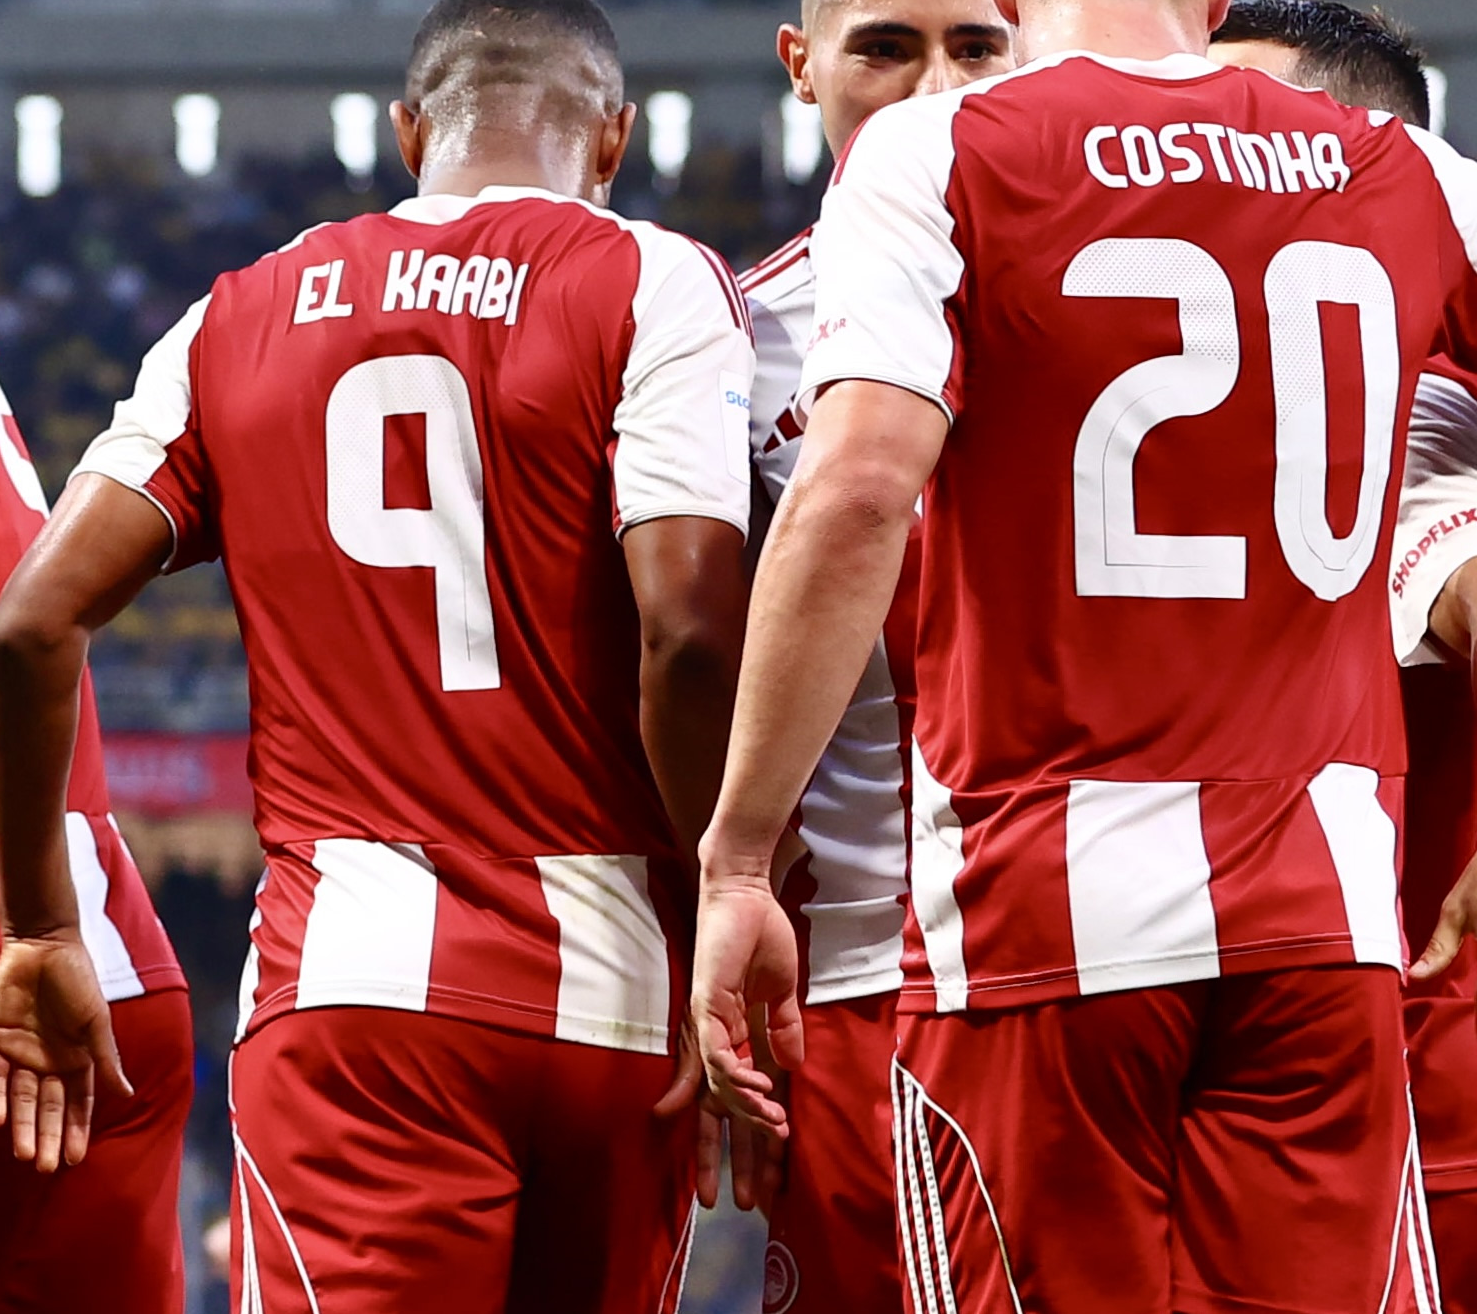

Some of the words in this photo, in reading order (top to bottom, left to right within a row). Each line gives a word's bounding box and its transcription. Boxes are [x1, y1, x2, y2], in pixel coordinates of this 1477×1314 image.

[1082, 121, 1351, 194] COSTINHA
[293, 259, 353, 325] EL
[381, 248, 529, 326] KAABI
[325, 354, 501, 692] 9
[1061, 237, 1400, 602] 20
